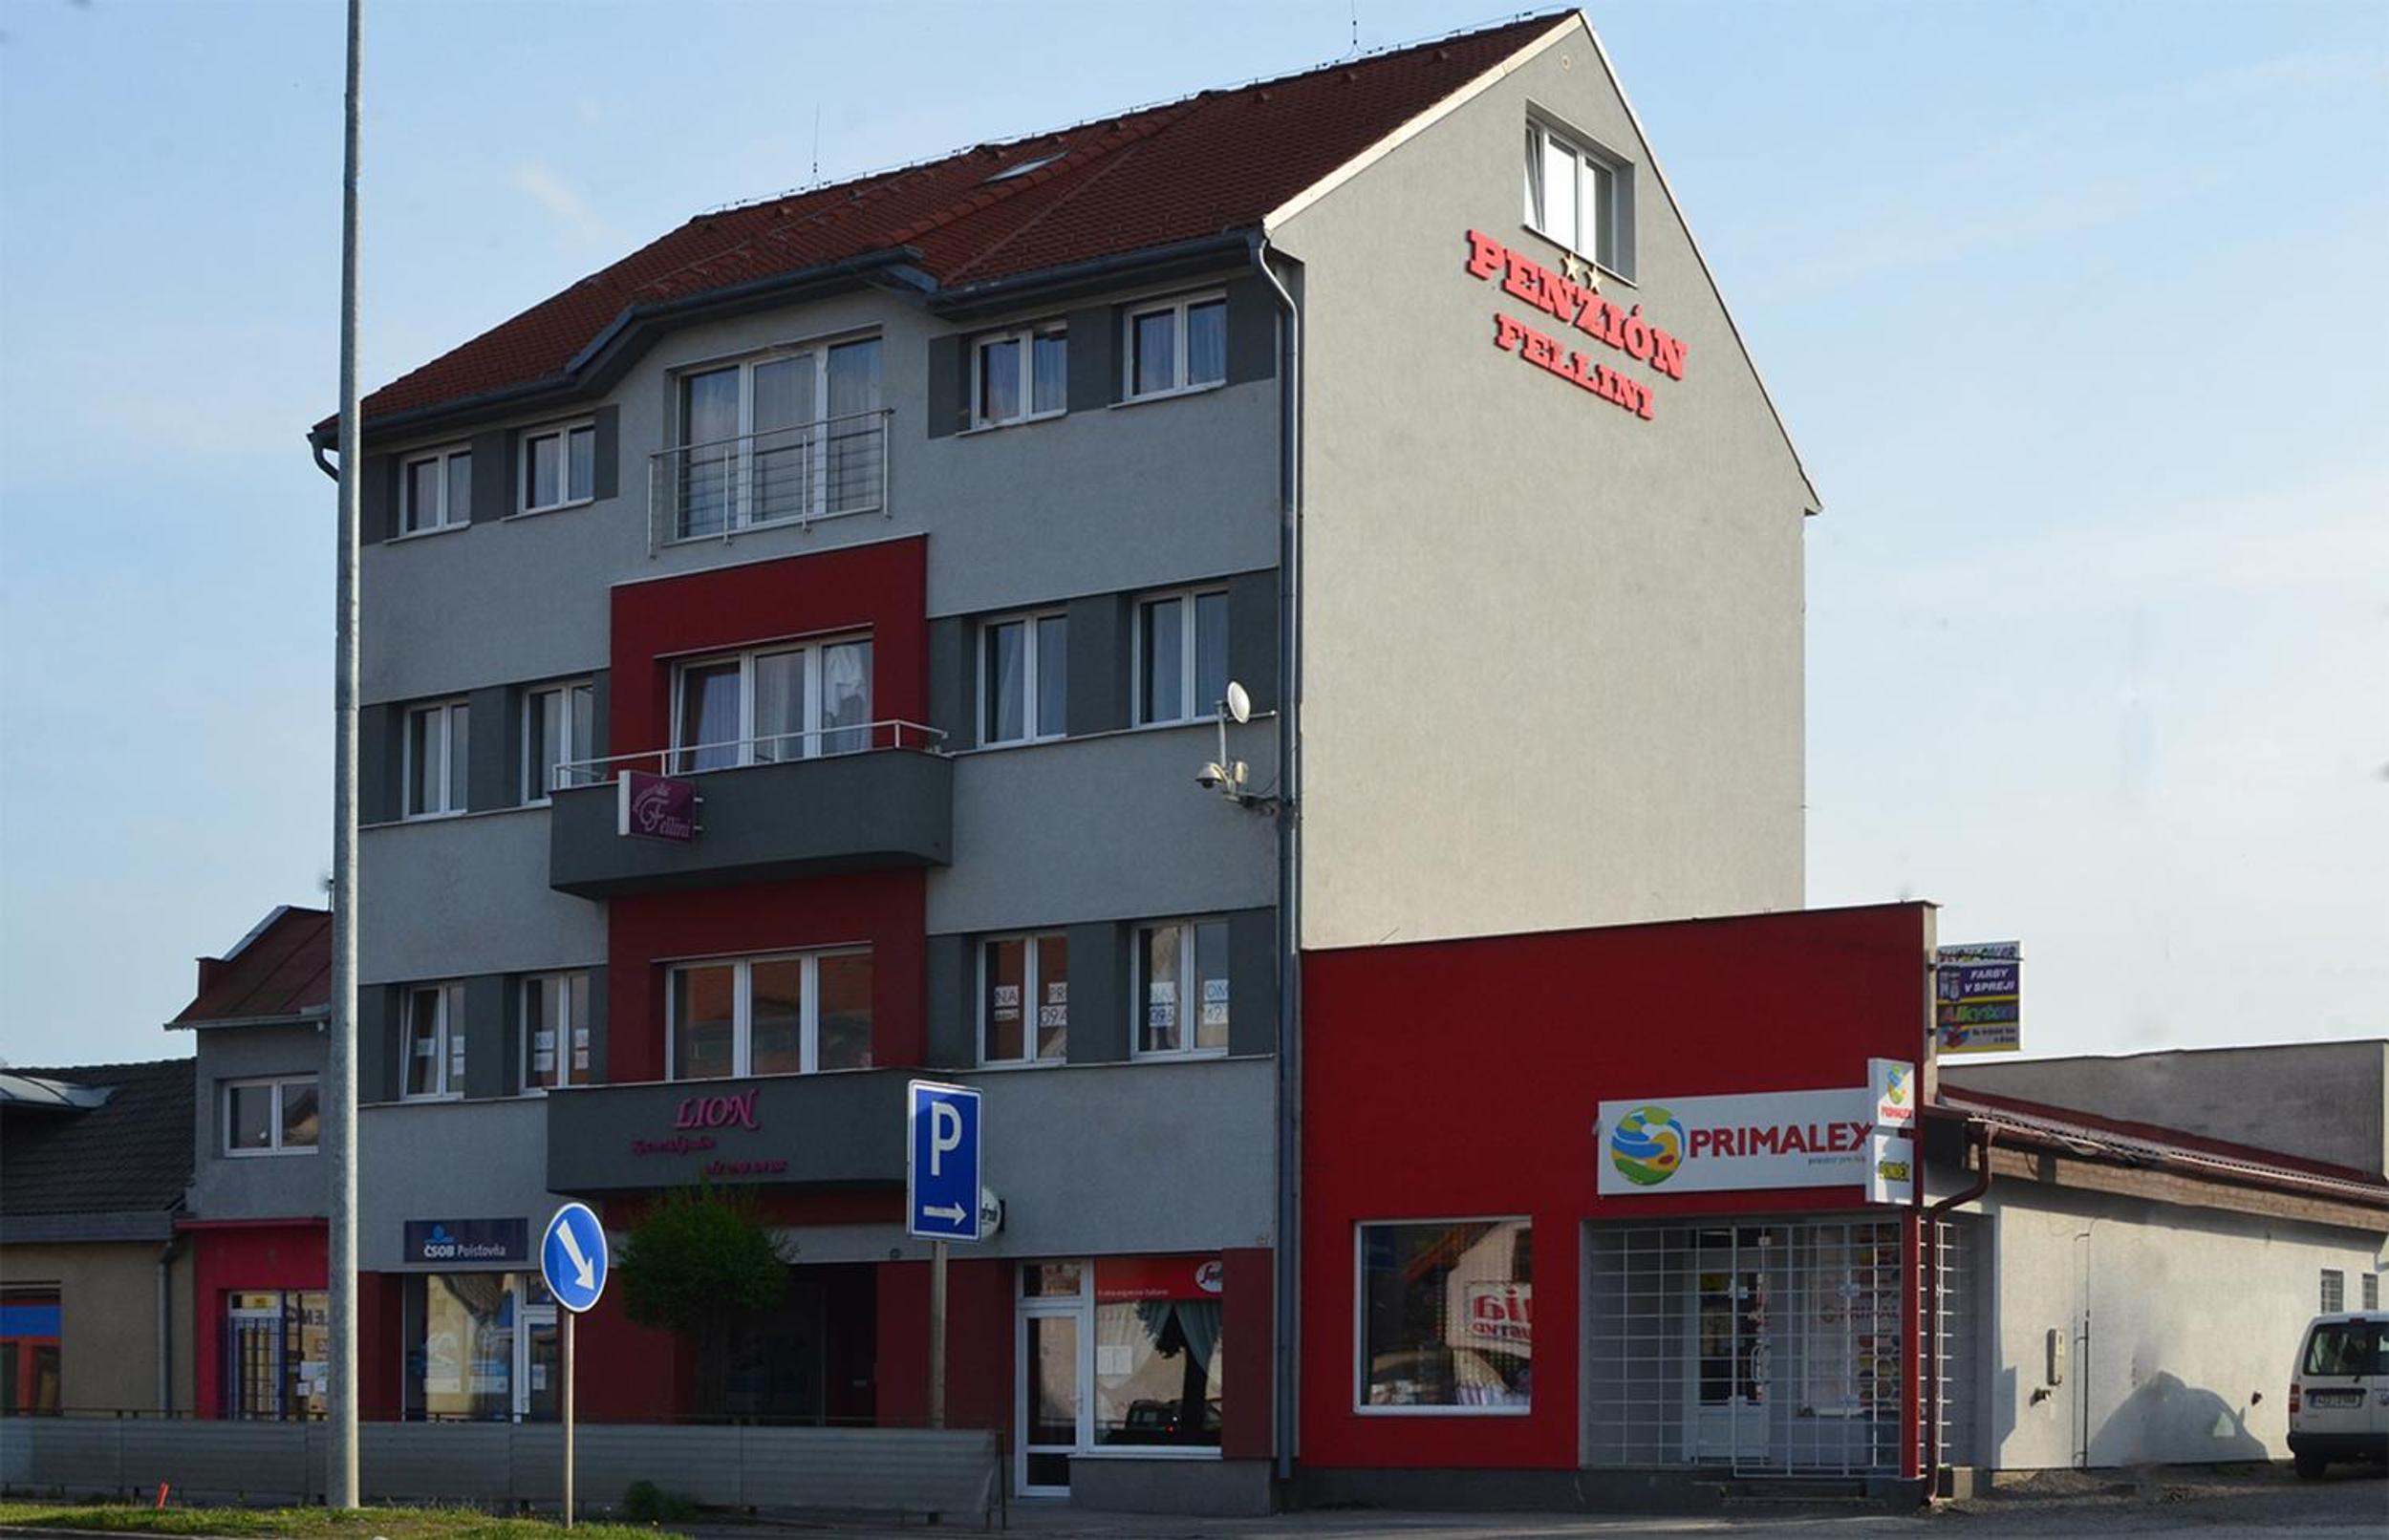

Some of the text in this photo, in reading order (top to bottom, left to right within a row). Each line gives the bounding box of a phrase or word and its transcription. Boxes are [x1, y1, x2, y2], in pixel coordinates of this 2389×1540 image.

[1465, 229, 1689, 381] PENZIÓN
[1494, 311, 1654, 420] FELLINI
[673, 1087, 761, 1130] LION
[930, 1101, 962, 1177] P
[1689, 1122, 1874, 1159] PRIMALEX
[423, 1242, 455, 1258] ČSOB
